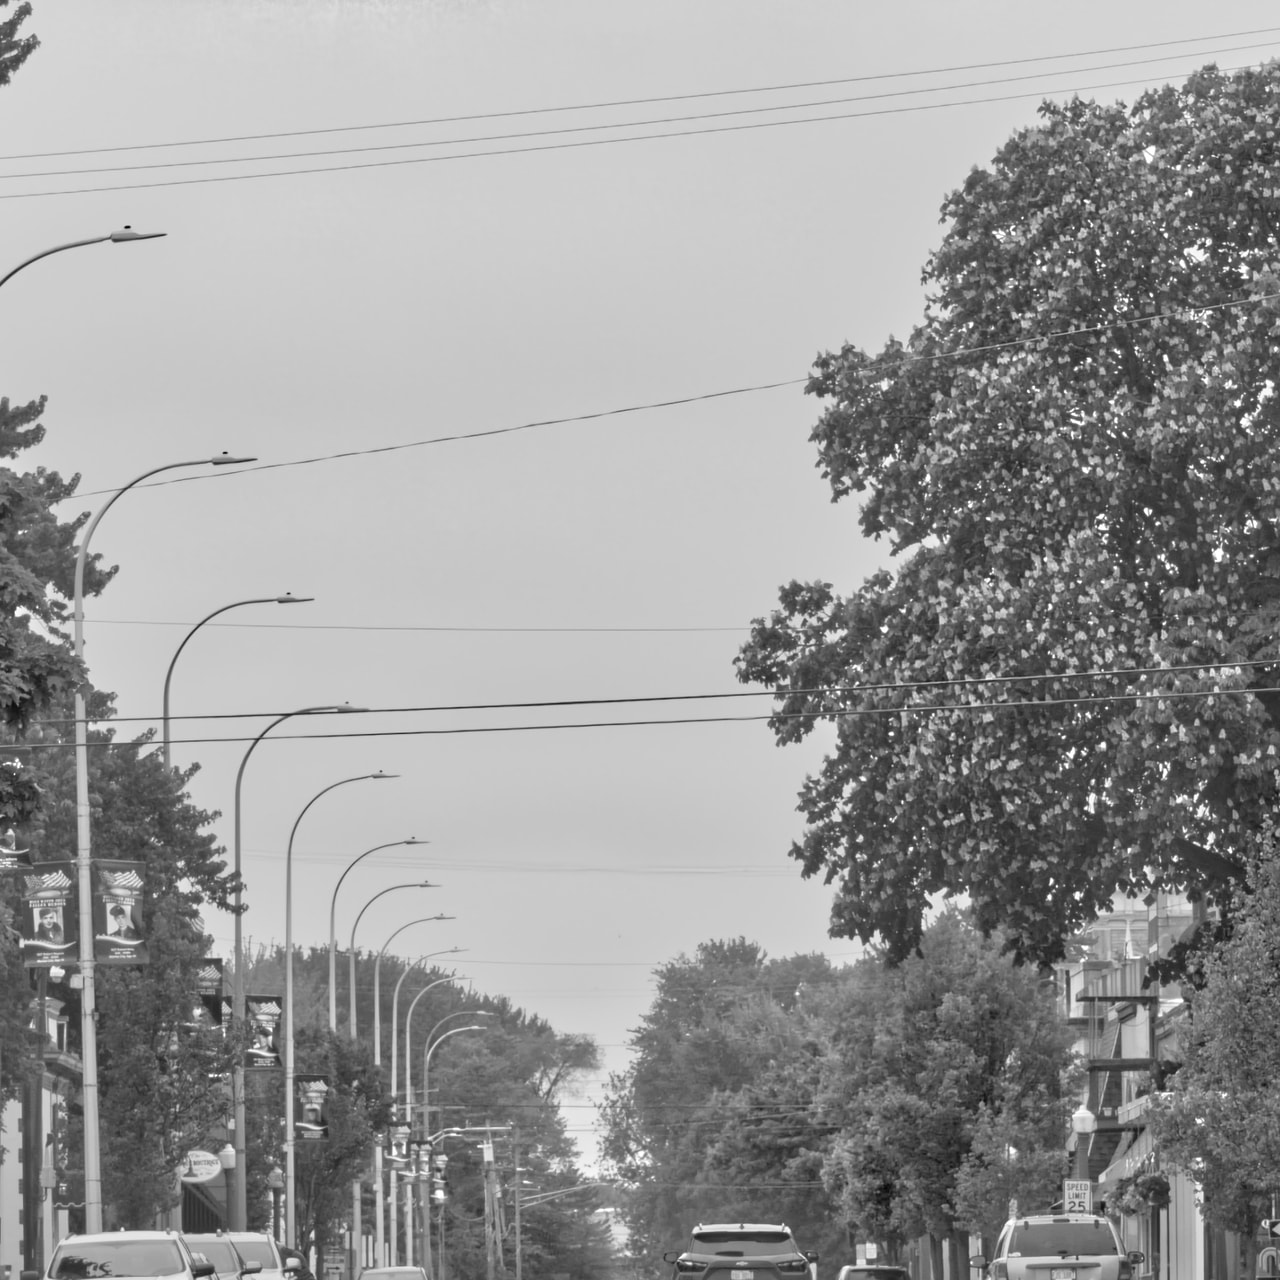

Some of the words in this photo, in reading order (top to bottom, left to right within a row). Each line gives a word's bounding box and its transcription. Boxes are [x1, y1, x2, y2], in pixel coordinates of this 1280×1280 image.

[1066, 1183, 1089, 1191] SPEED
[1067, 1192, 1087, 1200] LIMIT
[1068, 1201, 1086, 1213] 25
